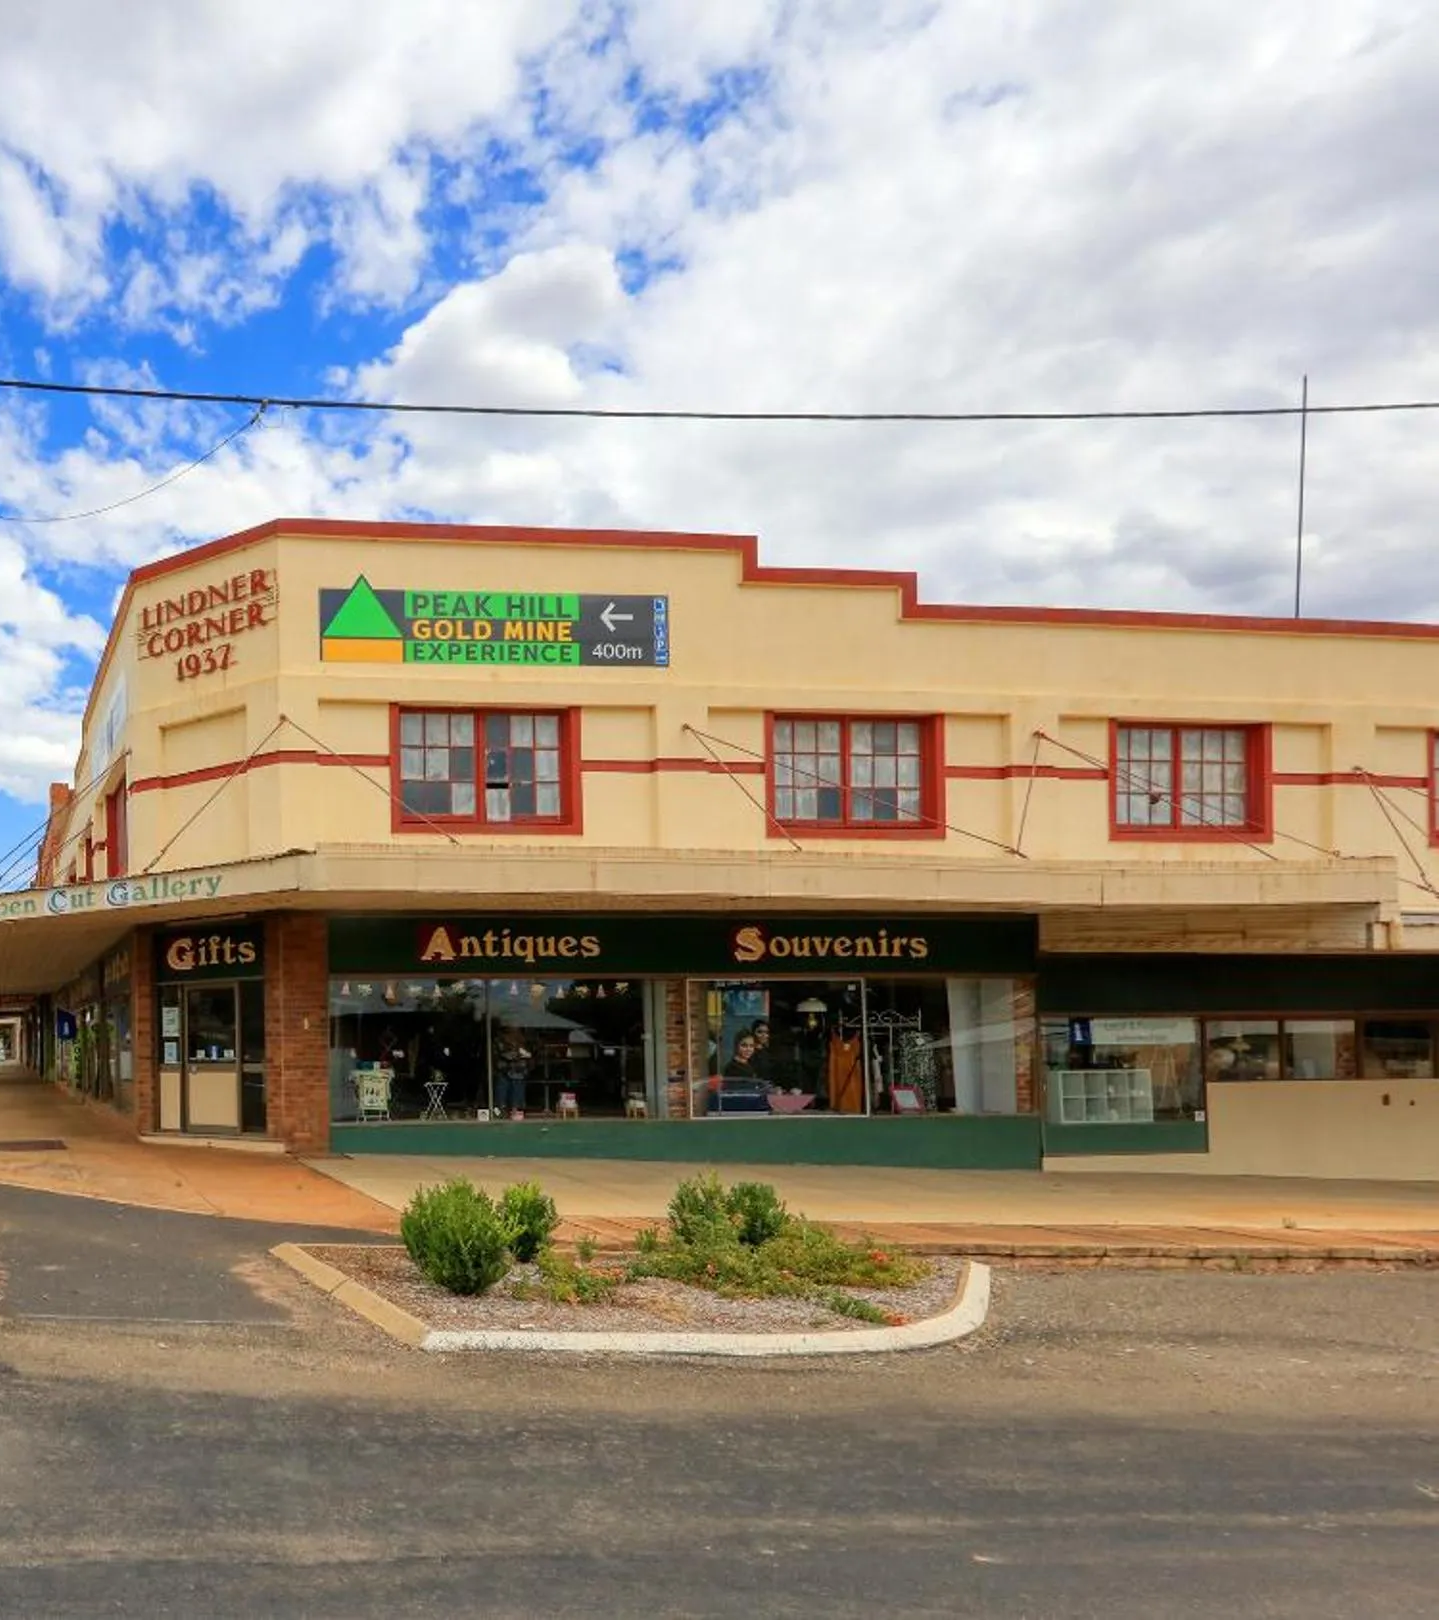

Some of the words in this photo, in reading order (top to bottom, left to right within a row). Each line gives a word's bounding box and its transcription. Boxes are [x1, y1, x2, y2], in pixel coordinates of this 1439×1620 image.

[142, 569, 271, 630] LINDNER
[411, 593, 494, 617] PEAK
[506, 595, 573, 619] HILL
[147, 602, 268, 657] CORNER
[412, 619, 492, 640] GOLD
[504, 620, 573, 642] MINE
[176, 643, 231, 682] 1937
[413, 642, 573, 663] EXPERIENCE
[591, 643, 643, 660] 400m
[46, 889, 96, 914] Cut
[106, 875, 223, 906] Gallery
[166, 935, 257, 970] Gifts
[420, 926, 601, 963] Antiques
[734, 926, 928, 962] Souvenirs
